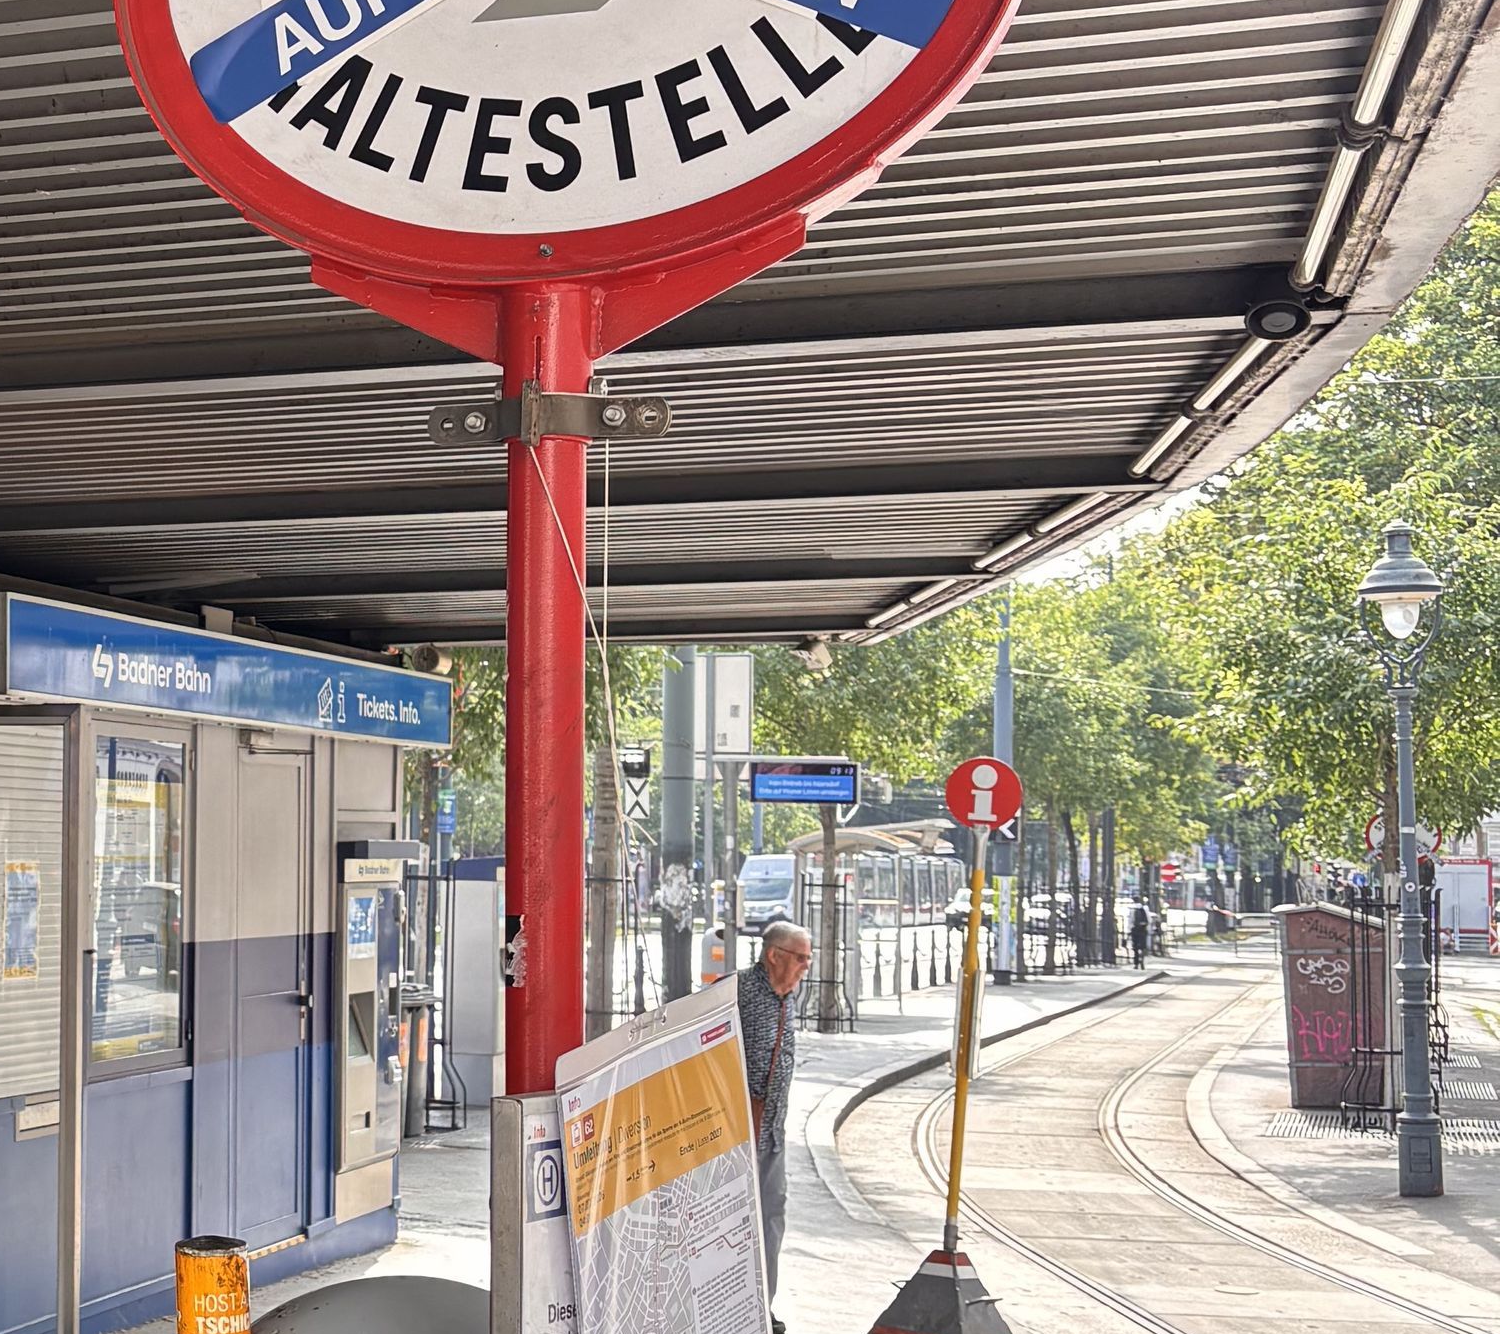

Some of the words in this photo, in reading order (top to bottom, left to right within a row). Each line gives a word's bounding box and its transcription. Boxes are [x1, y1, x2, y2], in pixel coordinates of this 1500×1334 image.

[266, 16, 880, 194] ALTESTELL
[118, 652, 173, 688] Badner
[175, 662, 212, 694] Bahn
[357, 693, 398, 721] Tickets.
[399, 699, 421, 725] Info.
[194, 1293, 237, 1313] HOST
